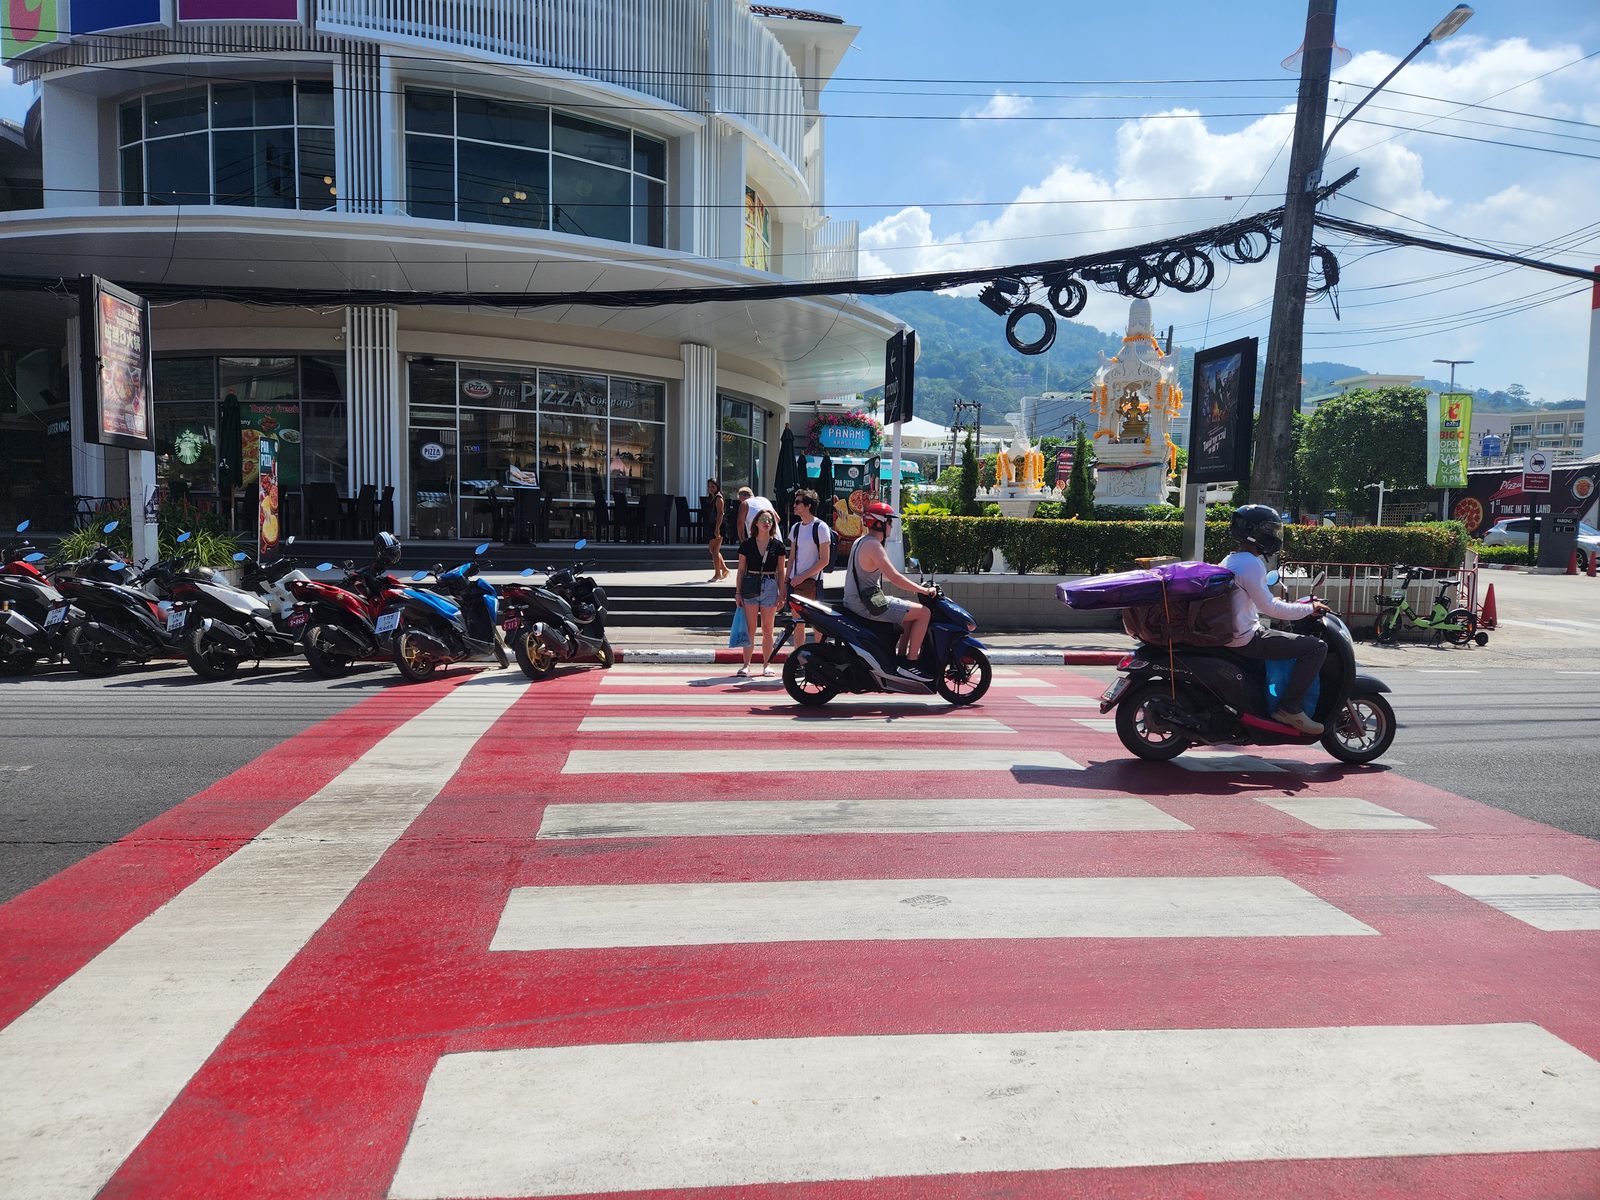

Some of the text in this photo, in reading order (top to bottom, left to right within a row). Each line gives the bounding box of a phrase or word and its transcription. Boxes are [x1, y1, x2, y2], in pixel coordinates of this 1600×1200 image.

[498, 387, 515, 397] The
[519, 384, 585, 407] PIZZA
[1440, 431, 1465, 440] BIG C
[1501, 504, 1514, 514] TIME
[1515, 504, 1522, 514] IN
